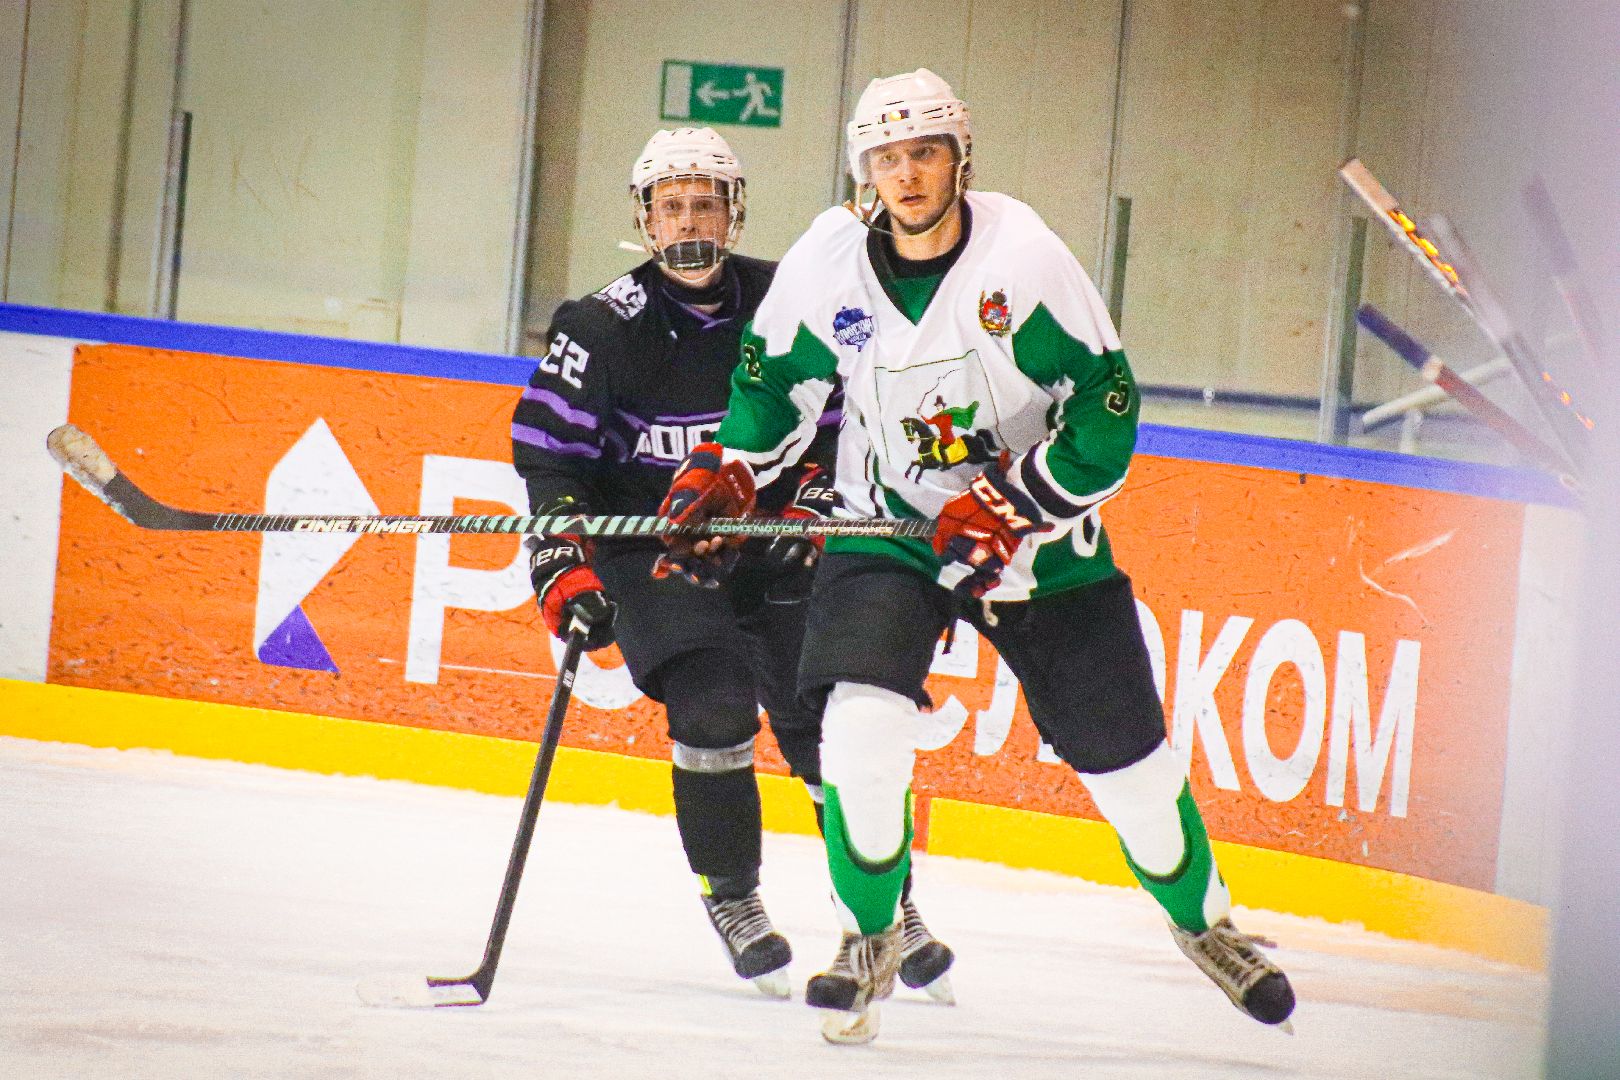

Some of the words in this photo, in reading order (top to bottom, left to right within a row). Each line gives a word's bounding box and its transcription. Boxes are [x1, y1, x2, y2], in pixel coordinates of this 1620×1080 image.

[539, 332, 590, 389] 22
[711, 524, 803, 534] DOMINATOR
[807, 526, 894, 536] PERFORMANCE
